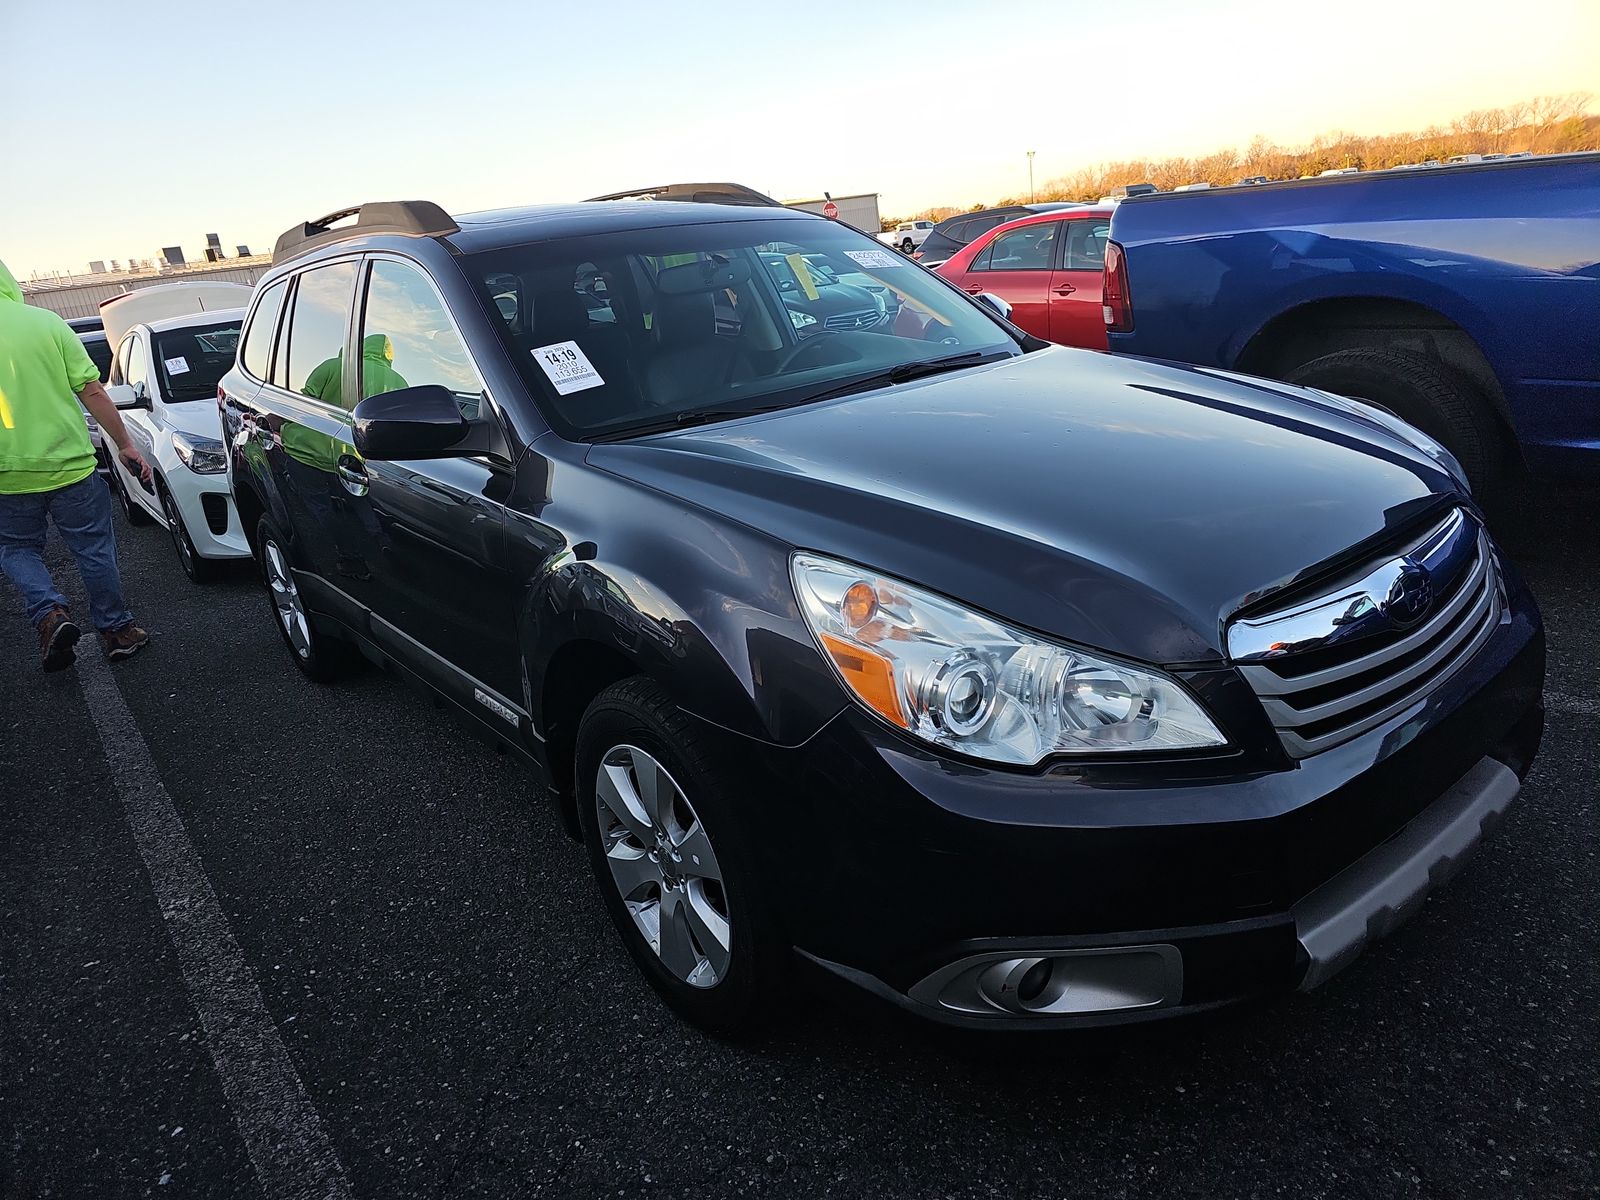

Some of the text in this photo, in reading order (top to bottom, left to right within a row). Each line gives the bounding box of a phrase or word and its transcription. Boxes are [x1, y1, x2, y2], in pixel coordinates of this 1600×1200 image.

[824, 208, 837, 217] STOP
[545, 349, 577, 365] 14:19
[557, 360, 577, 370] 2010
[555, 366, 588, 378] 113,655
